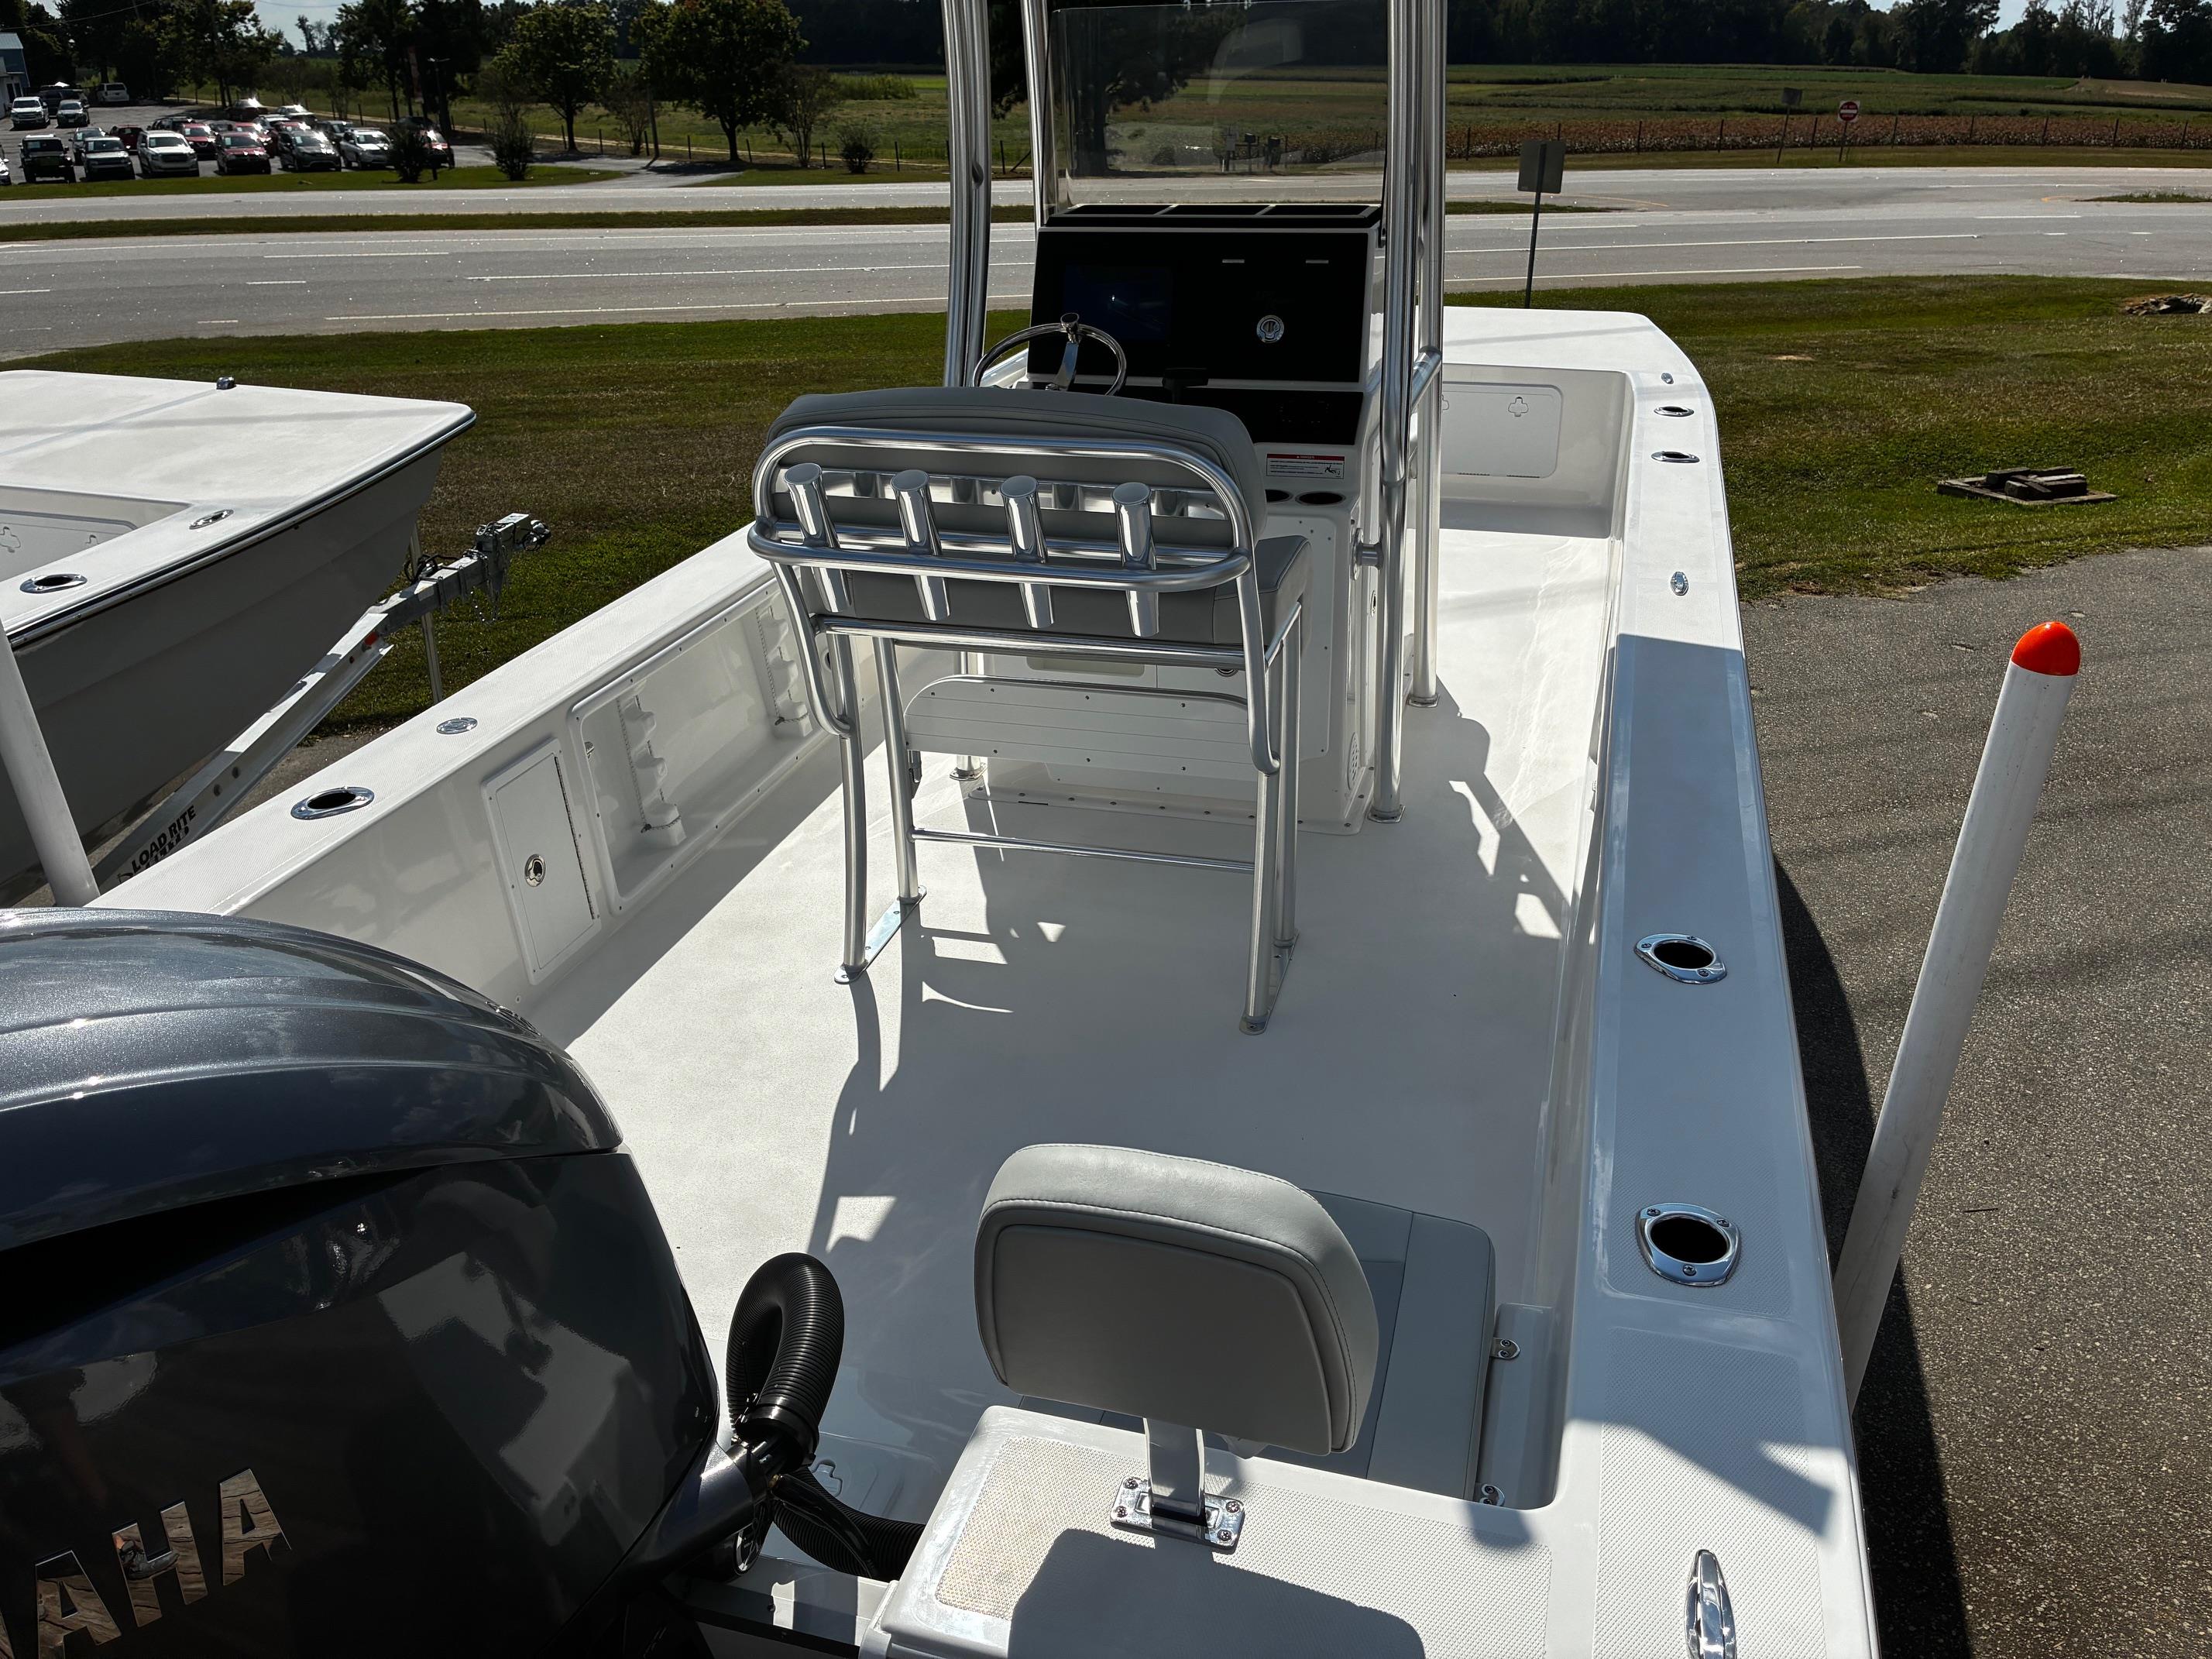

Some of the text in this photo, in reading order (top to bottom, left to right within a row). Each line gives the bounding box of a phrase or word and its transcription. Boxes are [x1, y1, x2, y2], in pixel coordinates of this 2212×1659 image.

[132, 833, 167, 874] LOAD
[168, 805, 196, 839] RITE
[0, 1468, 292, 1659] AHA
